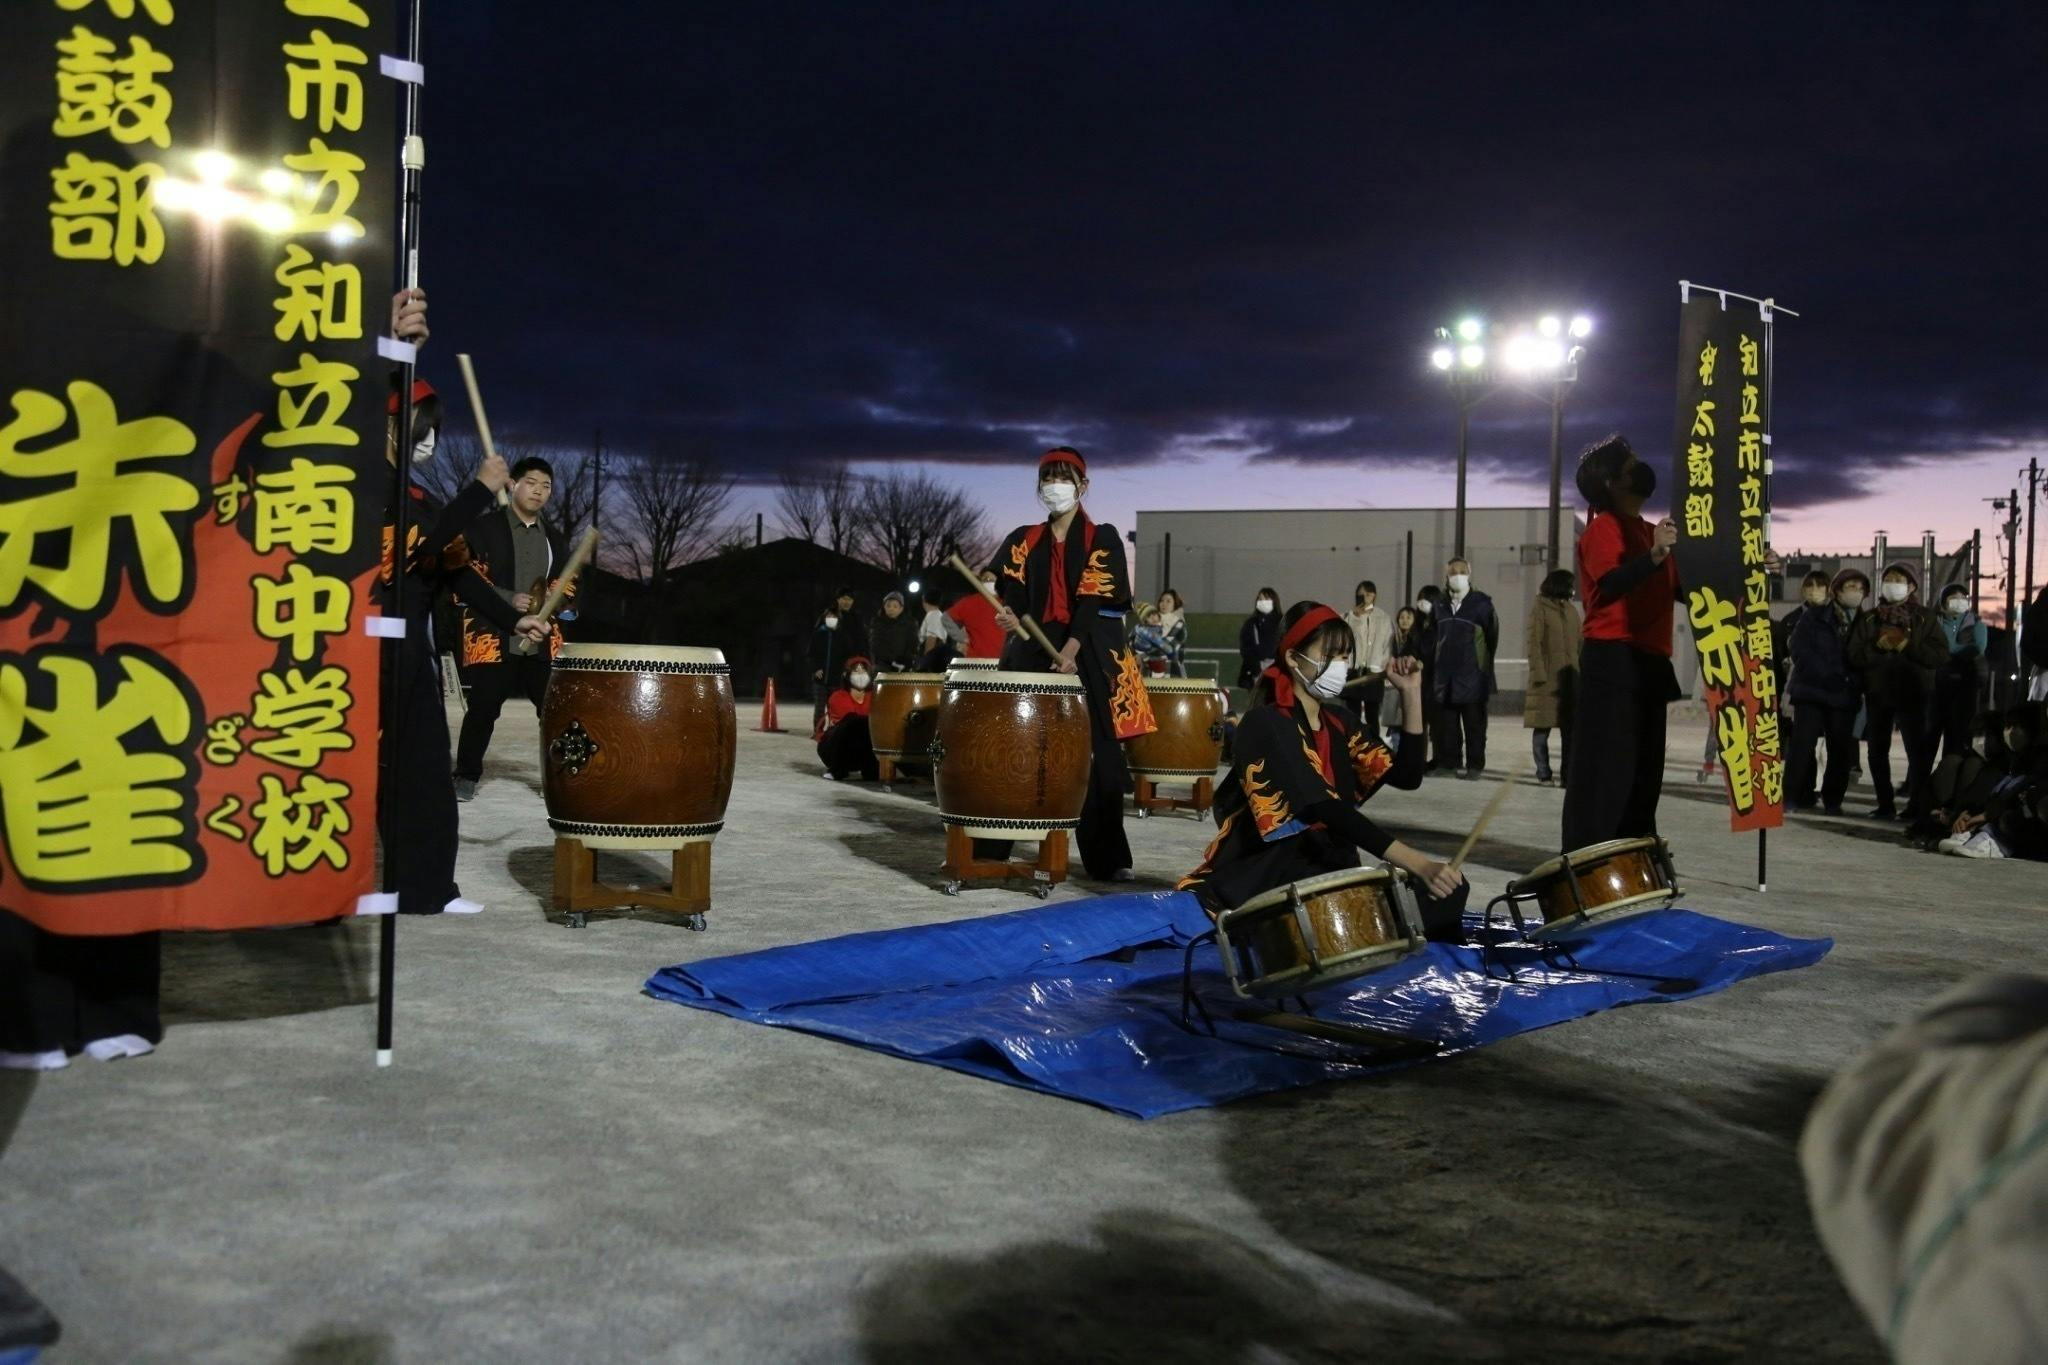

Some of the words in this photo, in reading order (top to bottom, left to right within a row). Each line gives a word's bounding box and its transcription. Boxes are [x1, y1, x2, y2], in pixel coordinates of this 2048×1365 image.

[0, 380, 199, 882] 朱雀
[251, 0, 370, 876] 市立知立南中学校
